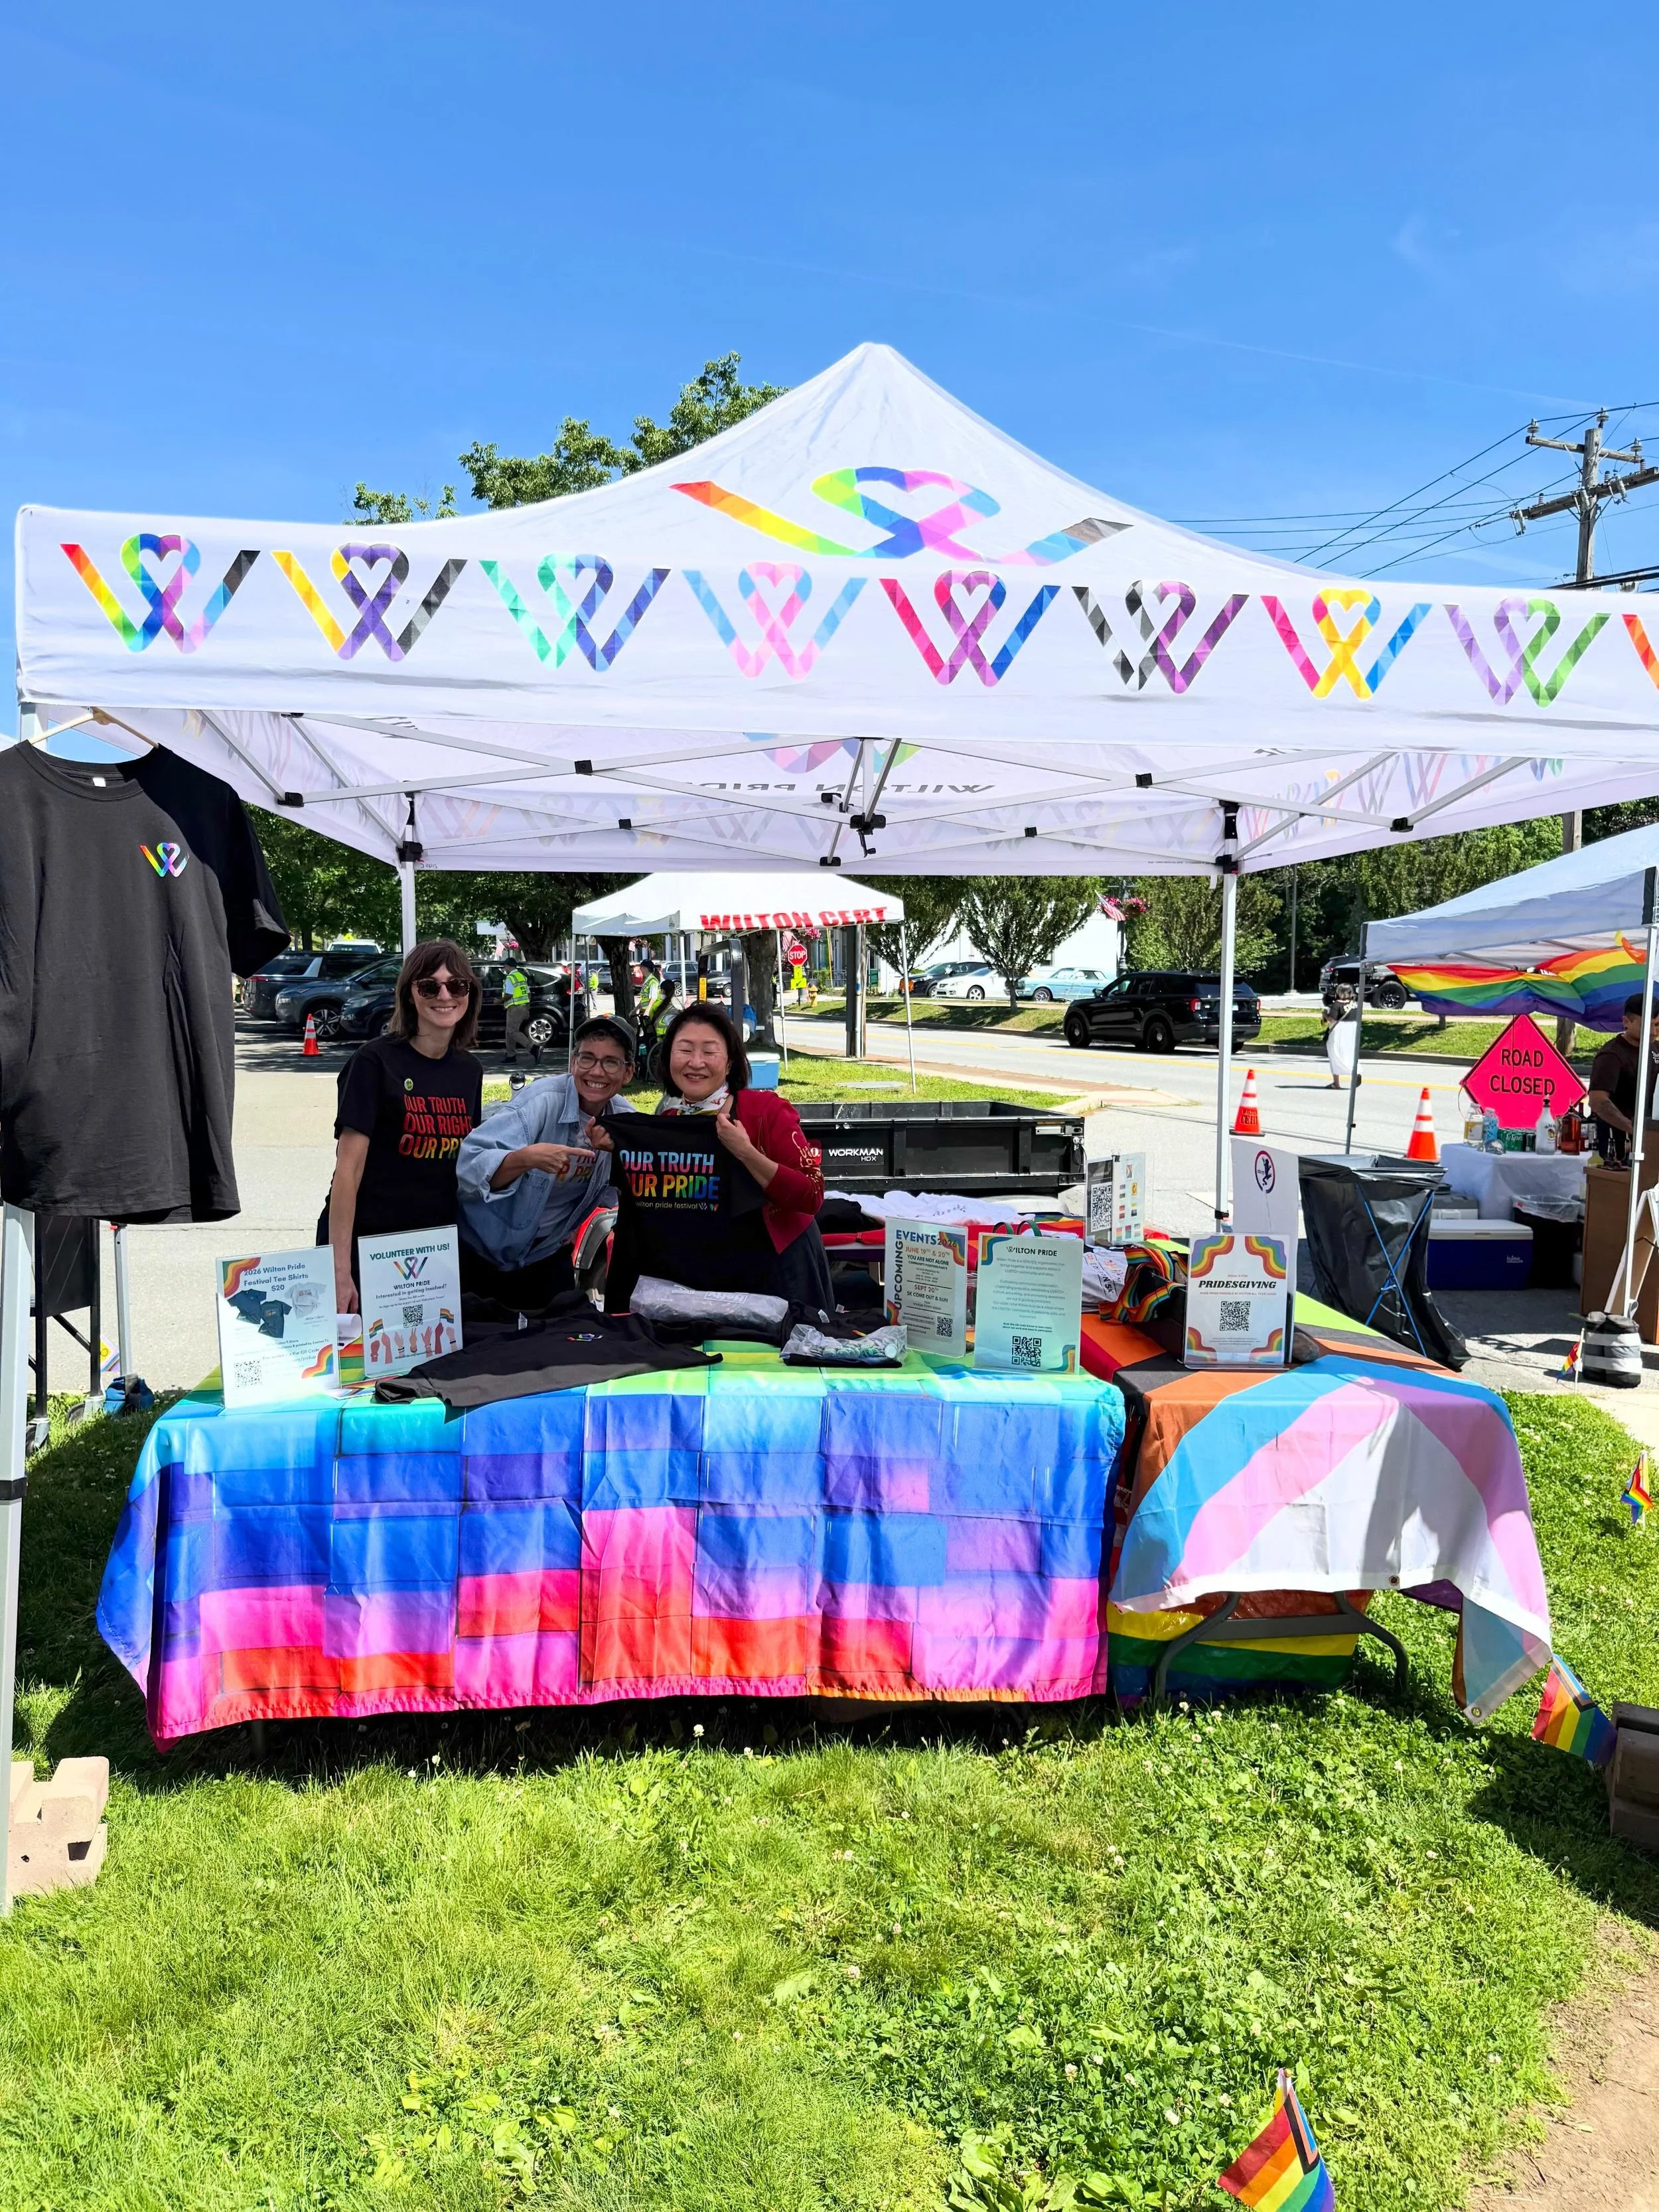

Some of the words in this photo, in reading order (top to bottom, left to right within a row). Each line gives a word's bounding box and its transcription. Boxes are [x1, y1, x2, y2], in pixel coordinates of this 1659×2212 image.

[699, 911, 814, 931] WILTON
[818, 907, 887, 926] CERT
[789, 950, 806, 960] STOP
[1501, 1049, 1544, 1068] ROAD
[1490, 1074, 1555, 1096] CLOSED
[404, 1094, 427, 1112] OUR
[428, 1096, 467, 1114] TRUTH
[403, 1112, 436, 1134] OUR
[399, 1134, 437, 1158] OUR
[829, 1148, 883, 1157] WORKMAN
[619, 1149, 654, 1171] OUR
[658, 1151, 715, 1174] TRUTH
[626, 1173, 658, 1197] UR
[662, 1175, 720, 1200] PRIDE
[896, 1230, 936, 1245] EVENTS
[370, 1248, 414, 1261] VOLUNTEER
[415, 1245, 435, 1254] WITH
[1006, 1246, 1036, 1255] WILTON
[894, 1240, 903, 1310] UPCOMING
[1198, 1280, 1277, 1289] PRIDESGIVING
[376, 1291, 401, 1299] Interested
